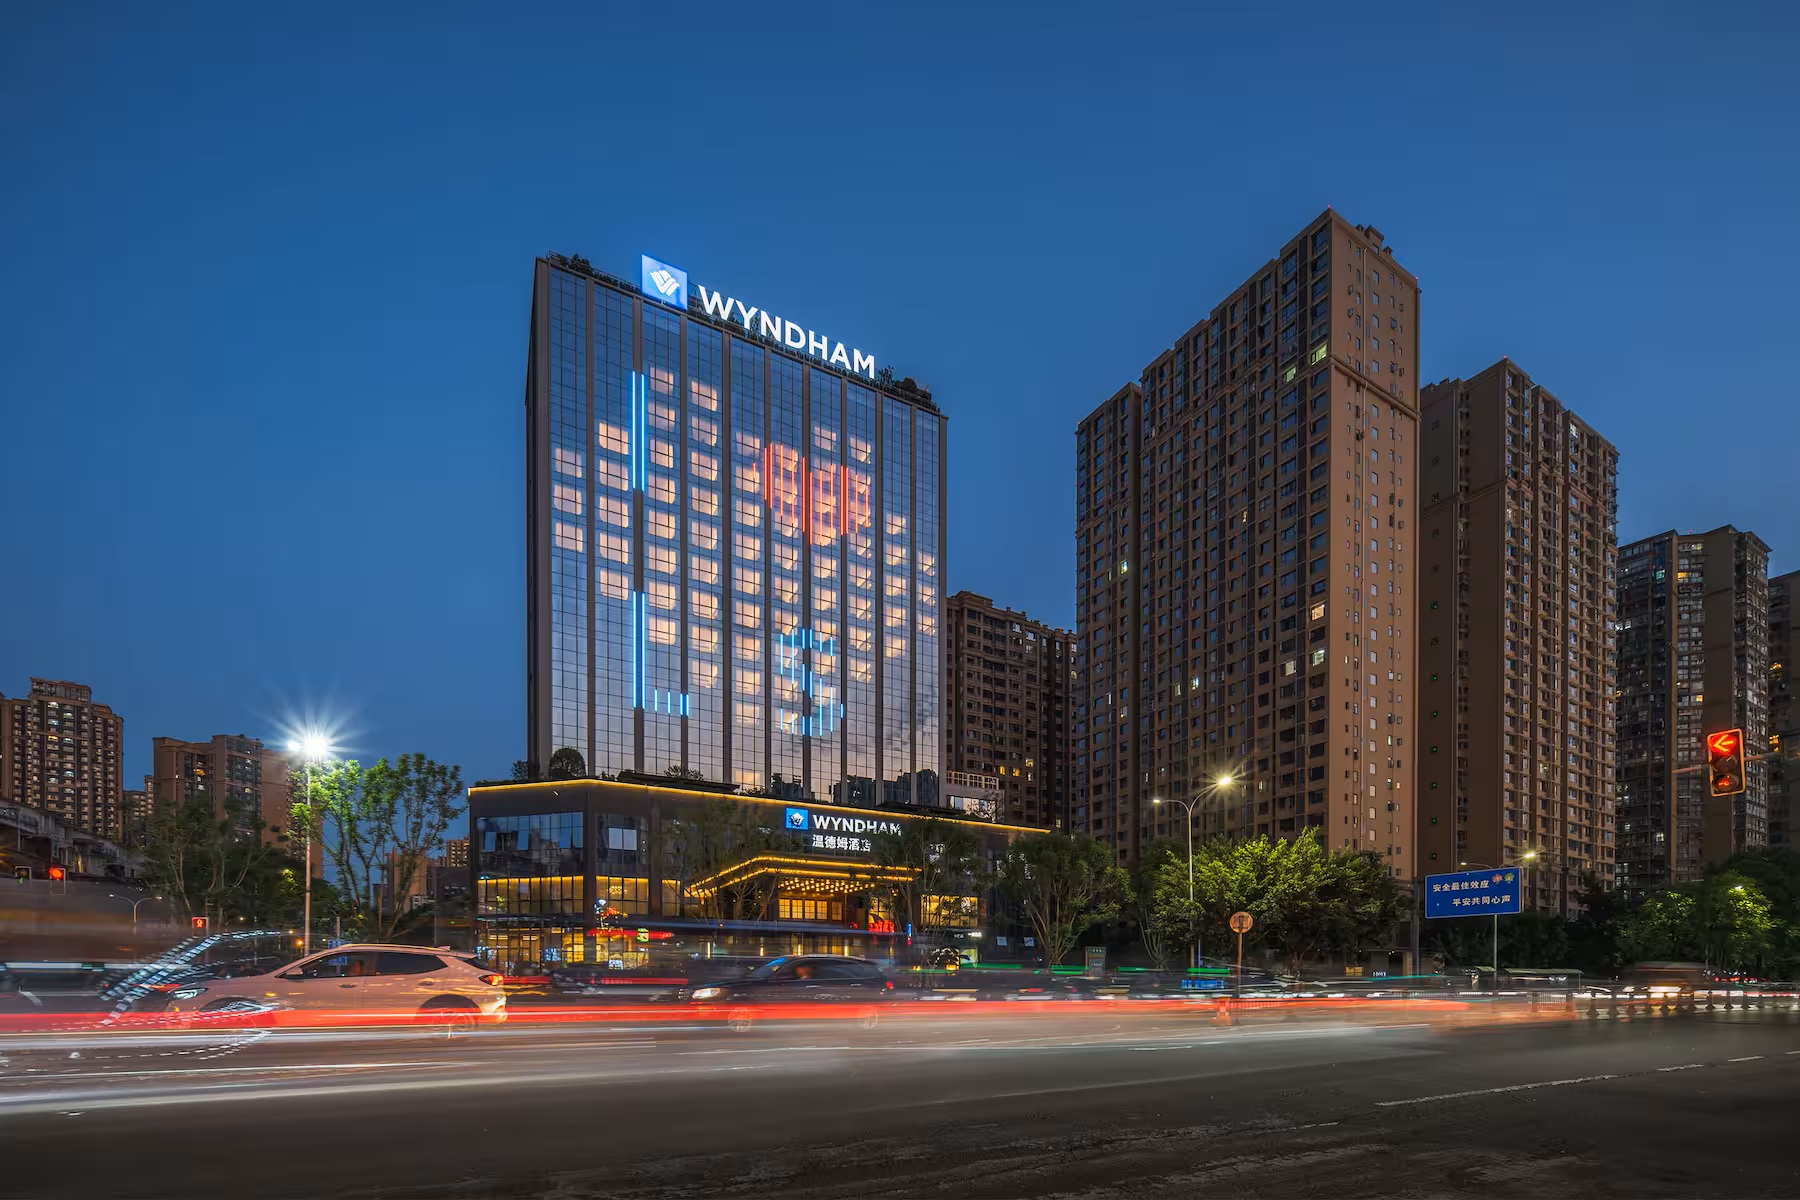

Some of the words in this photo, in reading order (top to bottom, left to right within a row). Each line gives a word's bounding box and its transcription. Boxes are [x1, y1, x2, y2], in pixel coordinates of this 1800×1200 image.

[698, 284, 875, 379] WYNDHAM
[812, 814, 902, 837] WYNDHAM
[1432, 880, 1490, 892] 安全最佳效应
[1452, 894, 1511, 907] 平安共同心声
